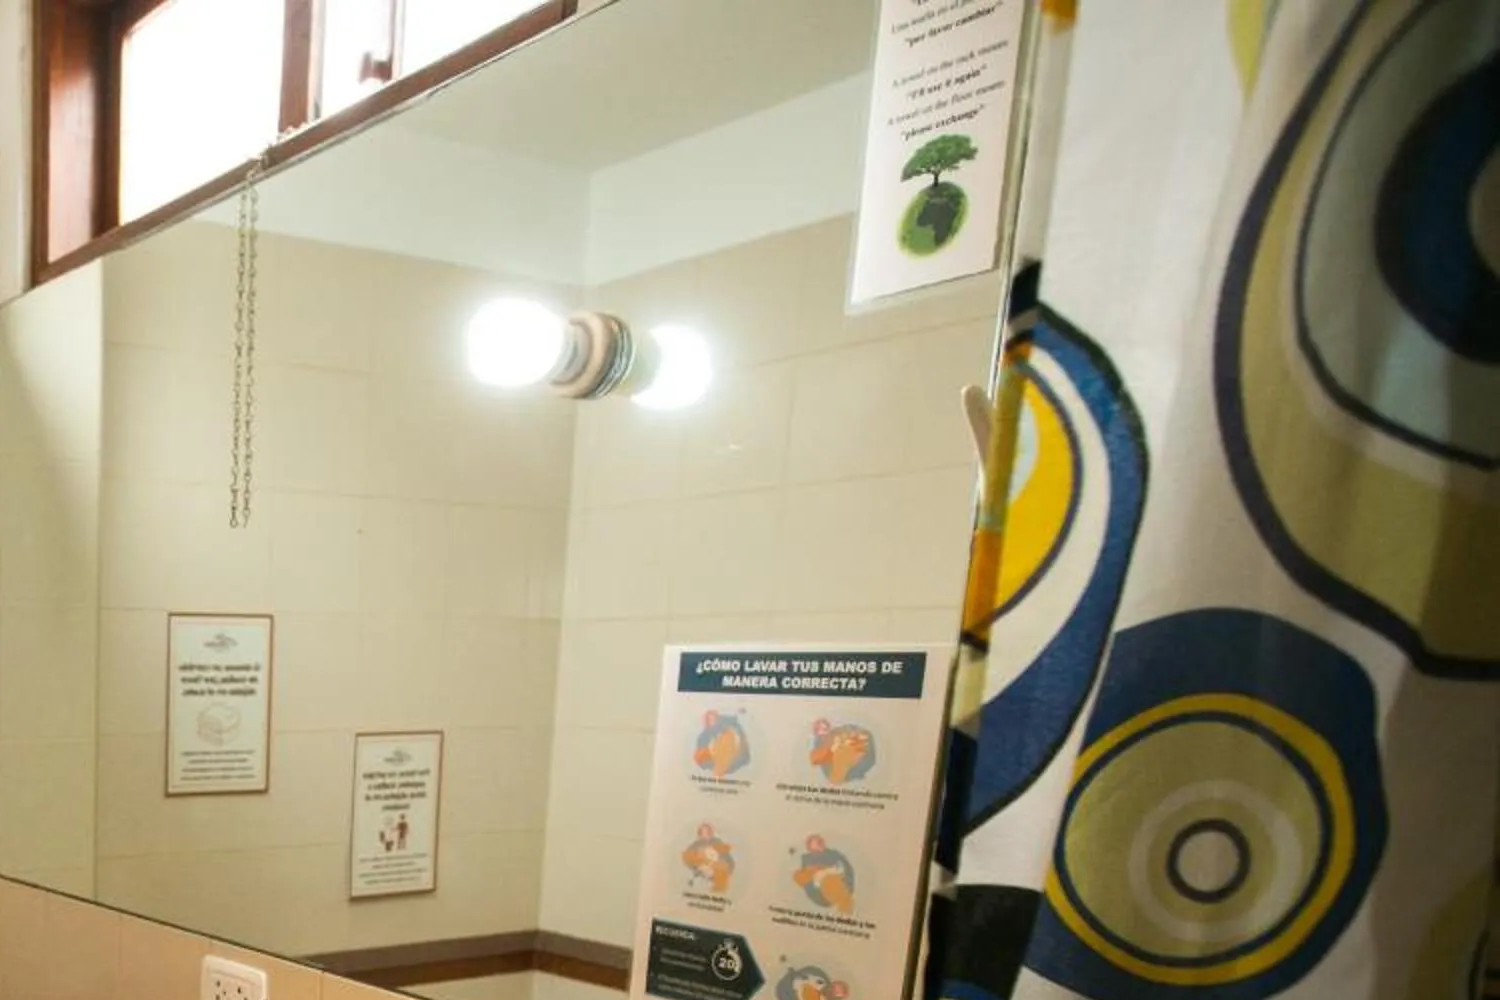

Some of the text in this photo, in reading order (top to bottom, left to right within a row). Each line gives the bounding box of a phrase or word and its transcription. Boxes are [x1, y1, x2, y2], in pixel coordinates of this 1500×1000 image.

[696, 659, 904, 674] ¿CÓMO LAVAR TUS MANOS DE
[722, 676, 867, 691] MANERA CORRECTA?
